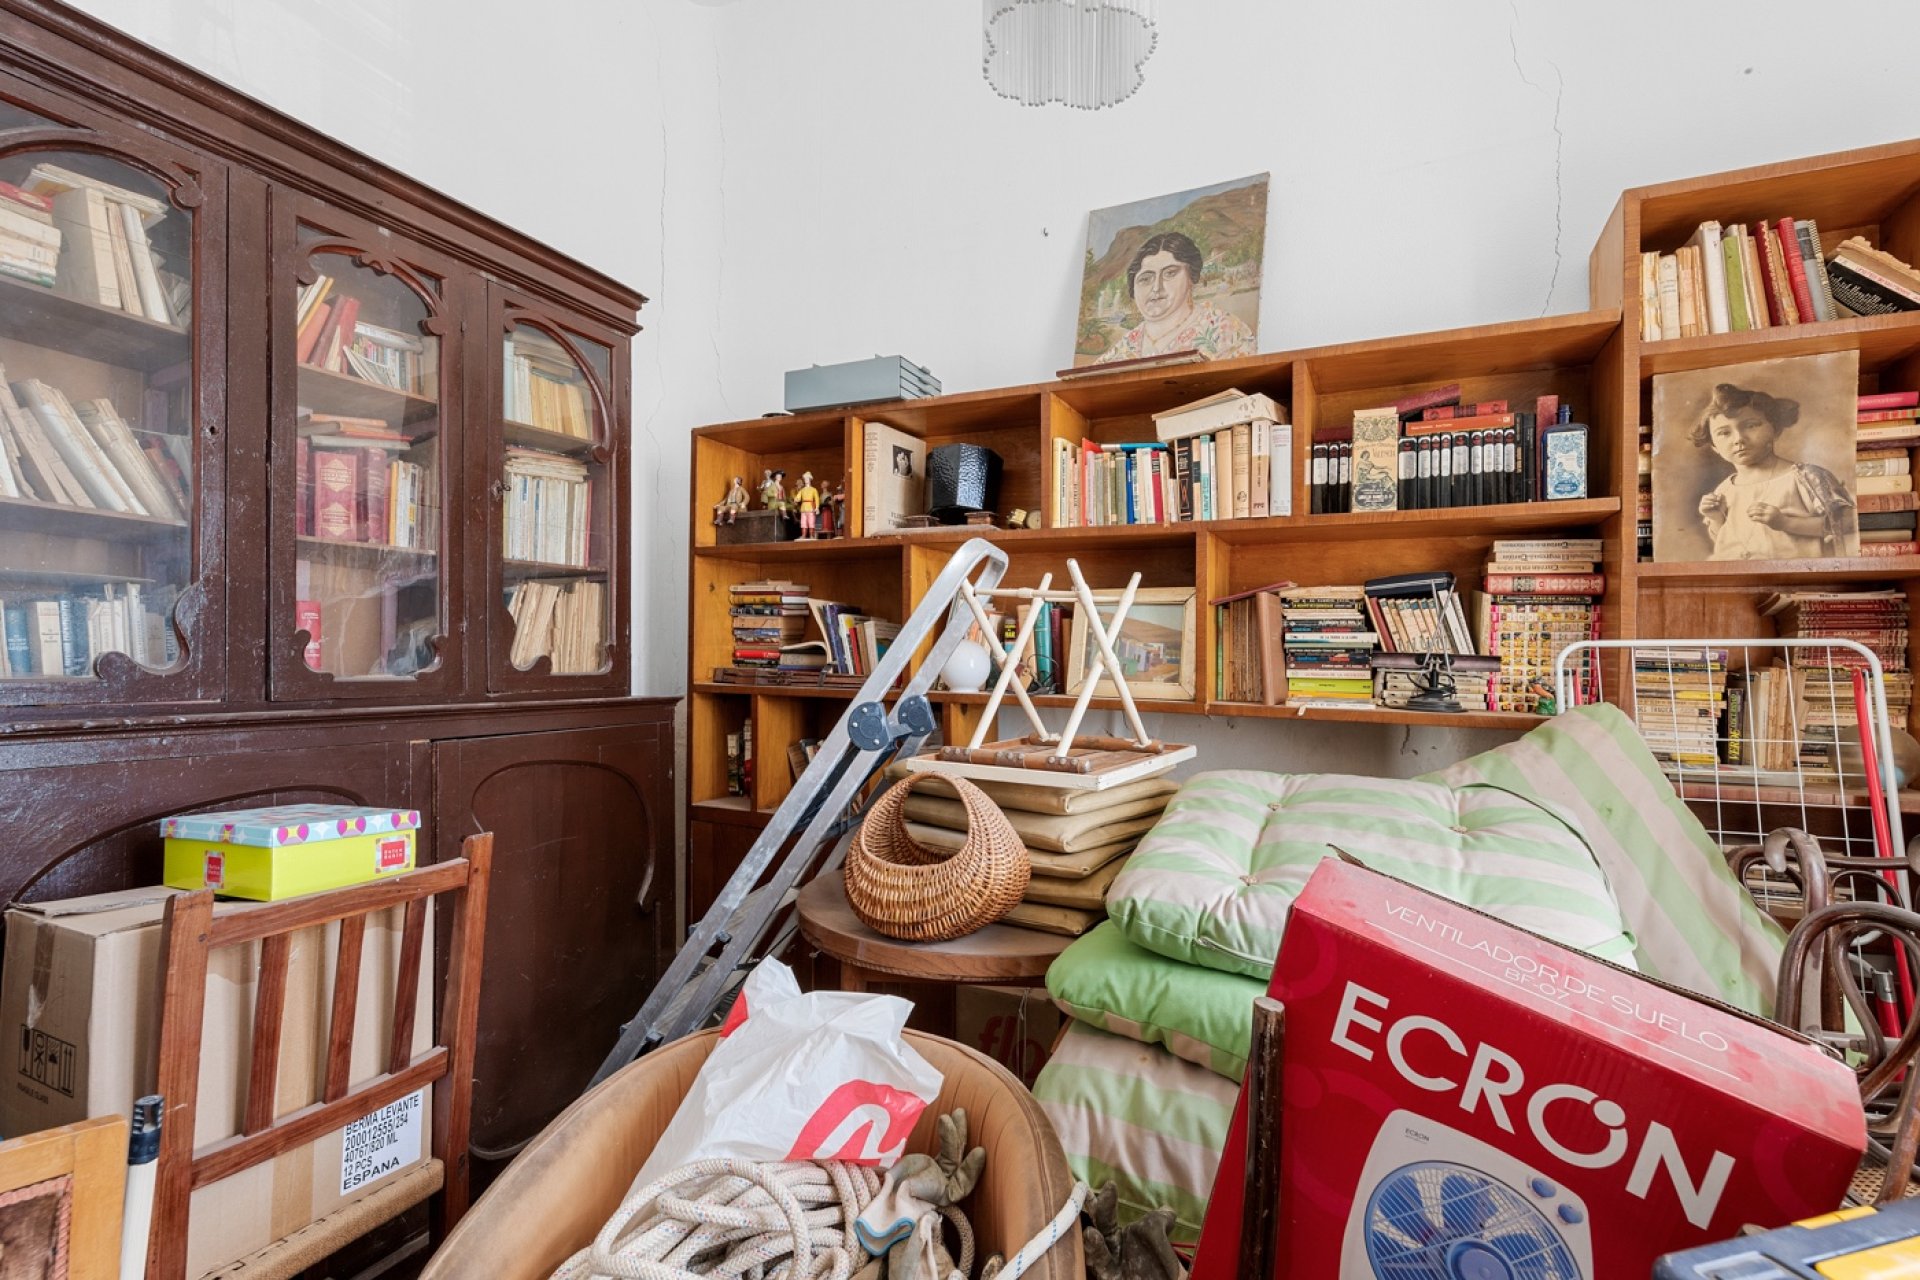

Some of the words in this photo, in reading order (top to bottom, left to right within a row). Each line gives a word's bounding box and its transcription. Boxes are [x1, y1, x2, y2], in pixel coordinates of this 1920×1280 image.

[1385, 899, 1559, 985] VENTILADOR
[1564, 974, 1607, 1005] DE
[1611, 994, 1729, 1052] SUELO
[1505, 967, 1571, 1000] BF-07
[381, 1094, 419, 1121] LEVANTE
[1330, 980, 1736, 1231] ECRON
[343, 1156, 400, 1190] ESPANA
[344, 1165, 353, 1178] 12
[355, 1156, 373, 1173] PCS
